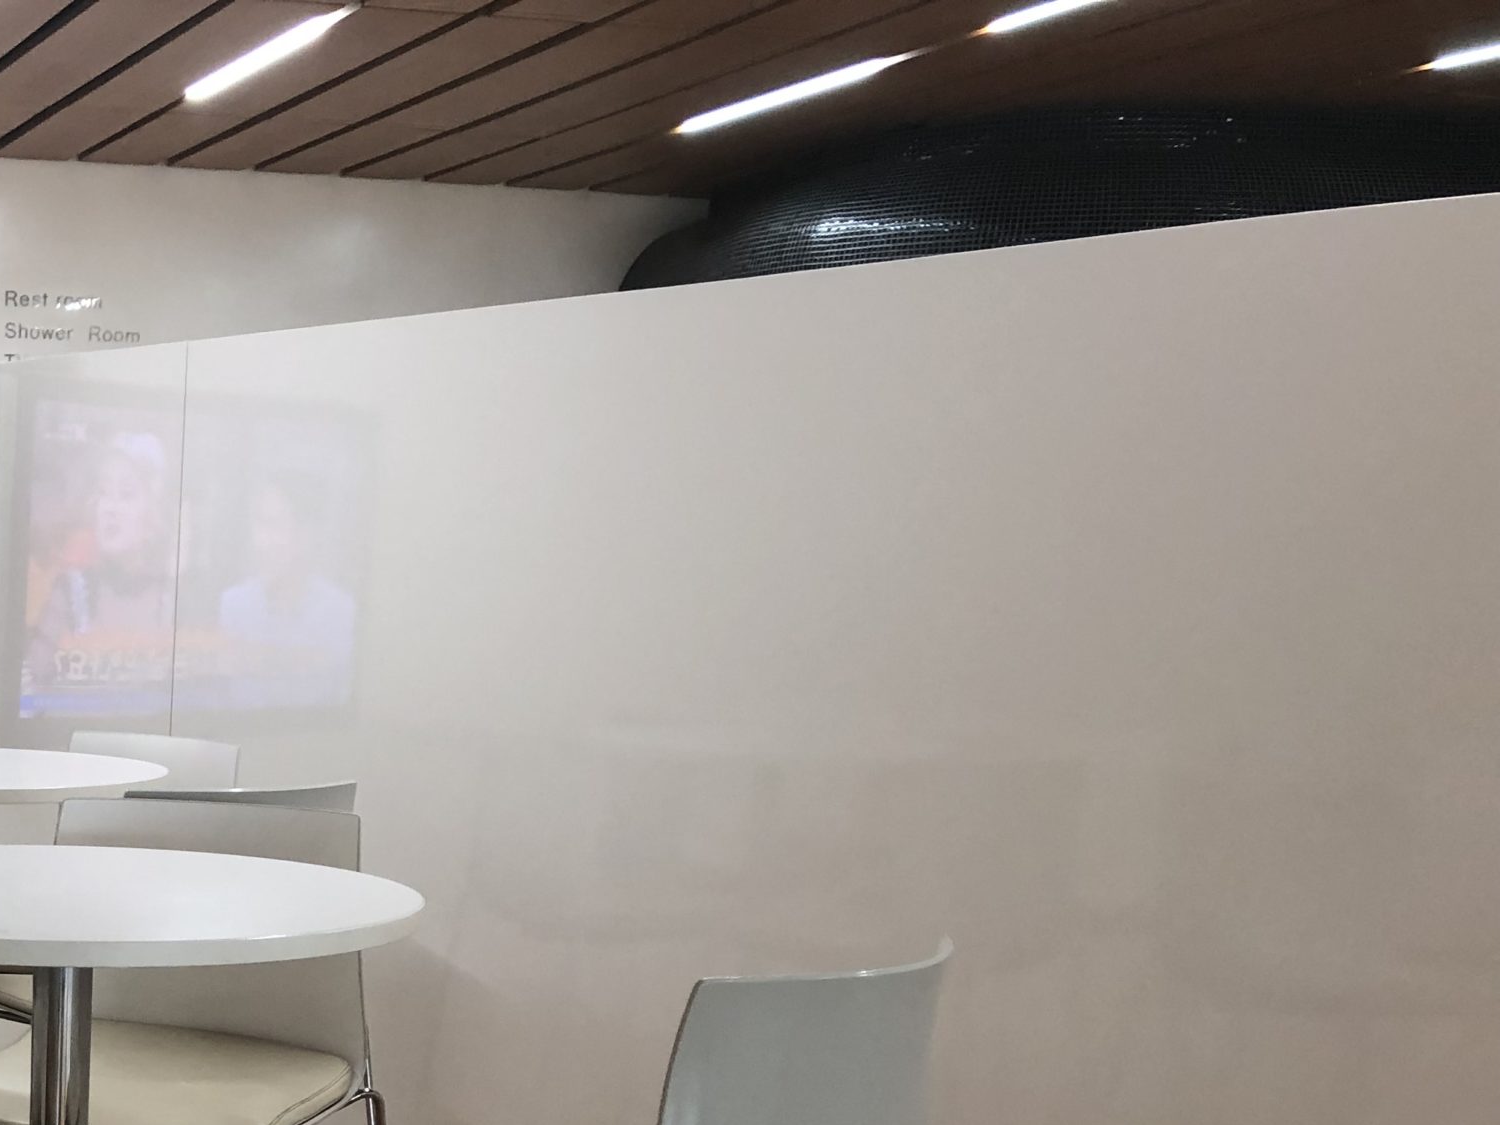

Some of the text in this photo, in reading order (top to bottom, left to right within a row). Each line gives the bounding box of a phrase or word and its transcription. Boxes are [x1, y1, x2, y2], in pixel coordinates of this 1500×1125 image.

[4, 290, 48, 308] Rest
[4, 321, 141, 343] Shower Room
